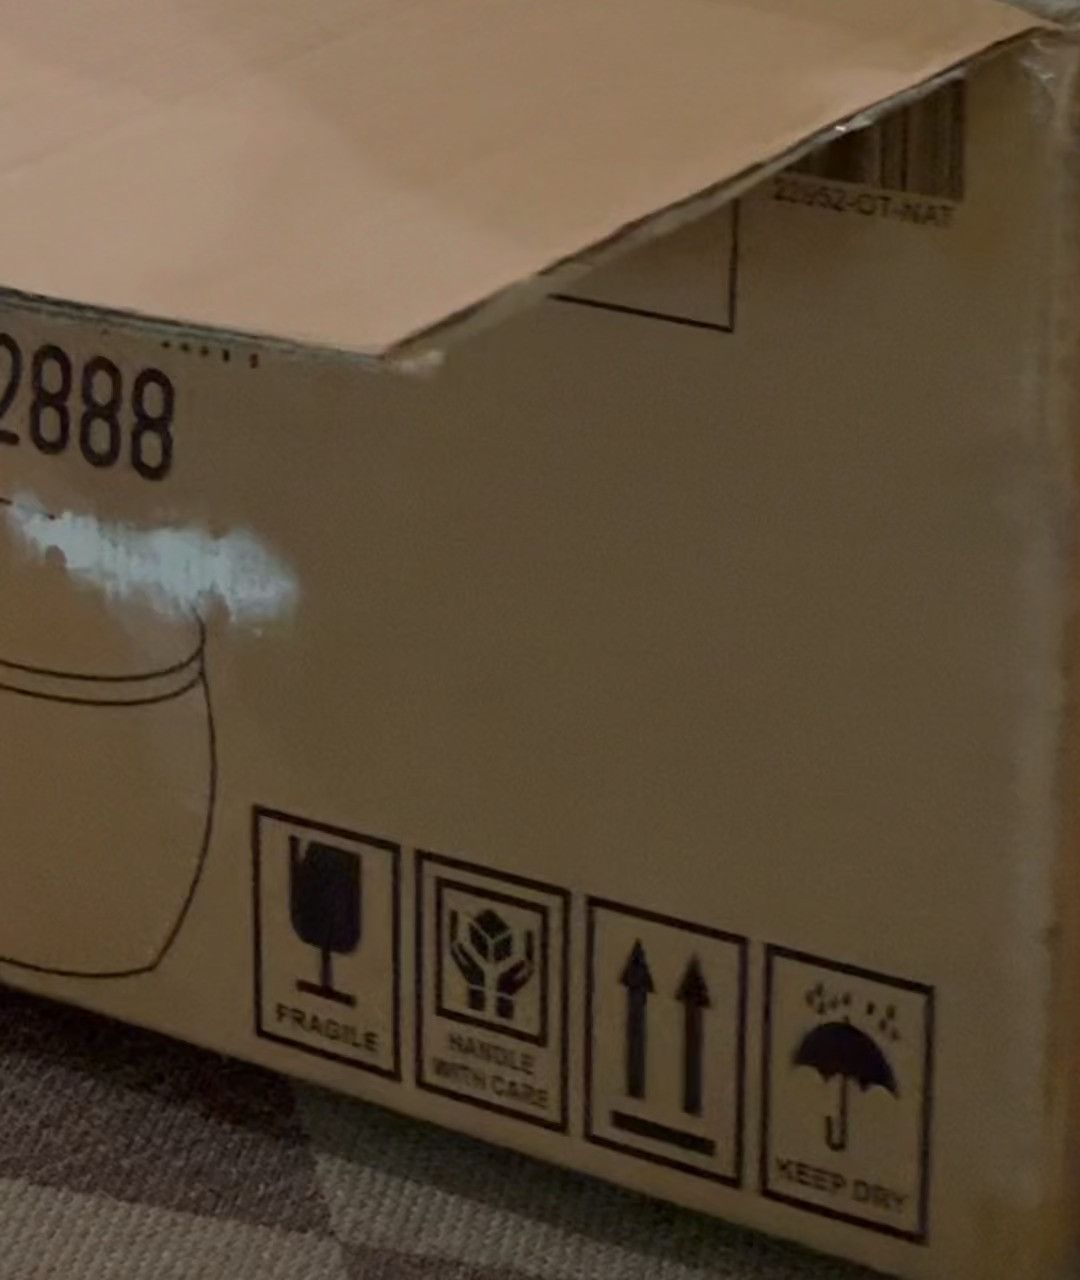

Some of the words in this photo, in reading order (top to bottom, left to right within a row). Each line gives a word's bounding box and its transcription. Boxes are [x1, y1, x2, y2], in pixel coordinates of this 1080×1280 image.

[0, 331, 175, 481] 2888
[275, 1001, 379, 1052] FRAGILE
[449, 1033, 536, 1076] HANDLE
[433, 1057, 491, 1095] WITH
[491, 1073, 549, 1110] CARE
[776, 1155, 848, 1196] KEEP
[852, 1178, 911, 1214] DRY
